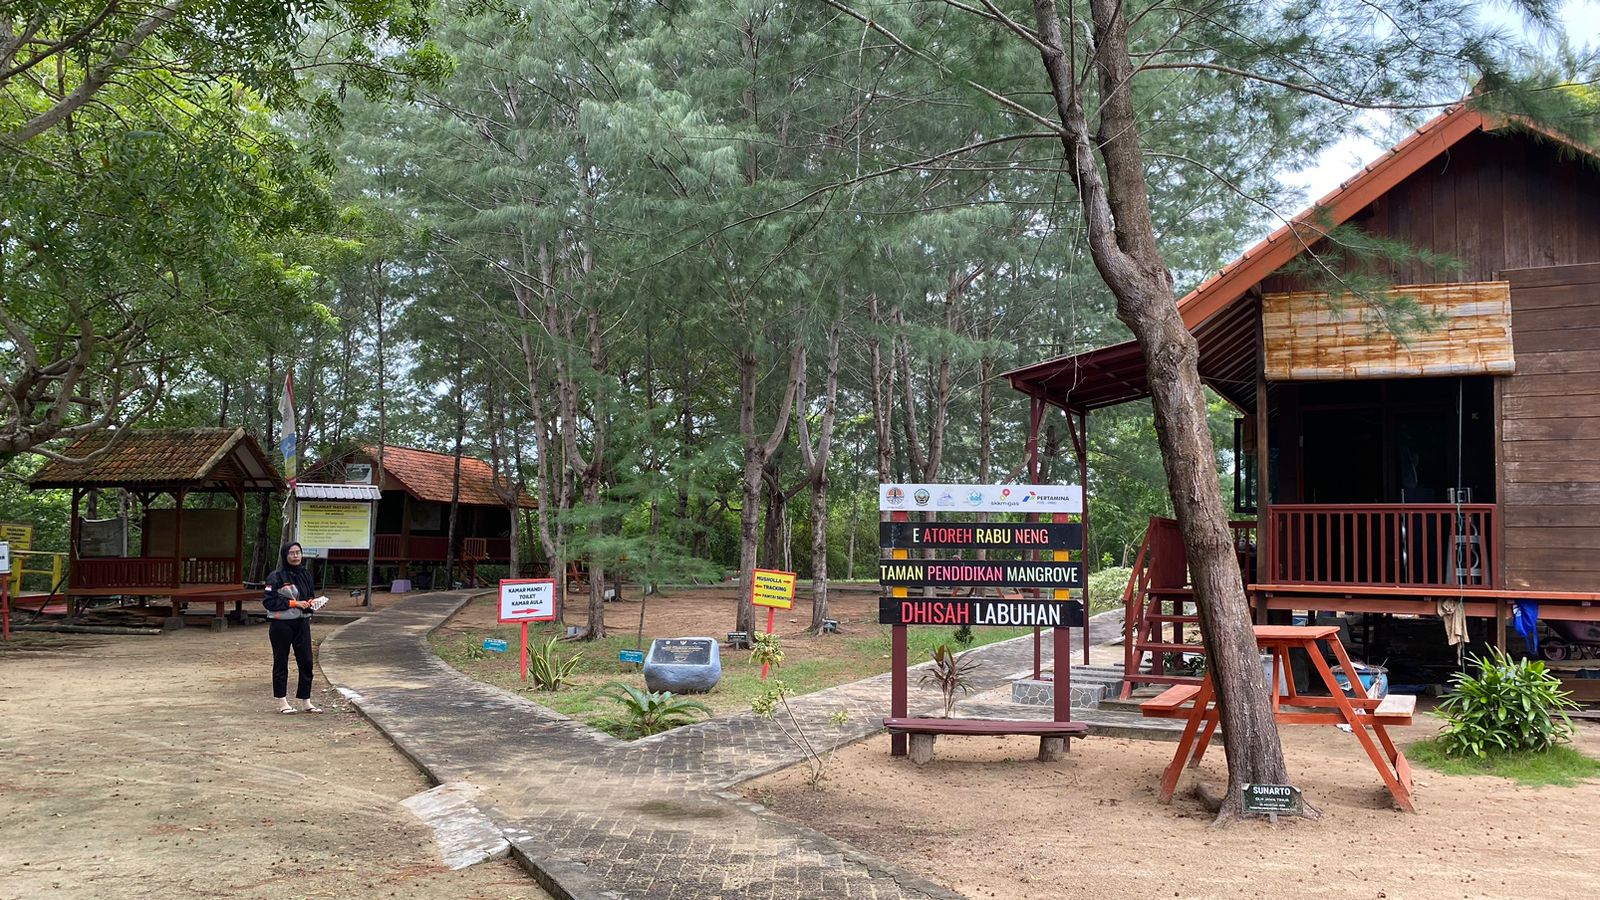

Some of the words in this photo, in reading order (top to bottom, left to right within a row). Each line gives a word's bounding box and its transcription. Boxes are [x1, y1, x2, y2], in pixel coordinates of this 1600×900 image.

[912, 527, 920, 543] E
[923, 527, 973, 544] ATOREH
[976, 528, 1011, 544] RABU
[1015, 529, 1049, 545] NENG
[756, 575, 782, 584] MUSHOLLA
[880, 565, 924, 581] TAMAN
[927, 565, 1003, 582] PENDIDIKAN
[1007, 566, 1078, 583] MANGROVE
[763, 584, 787, 592] TRACKING
[901, 602, 970, 624] DHISAH
[975, 603, 1062, 625] LABUHAN
[1252, 786, 1291, 796] SUNARTO
